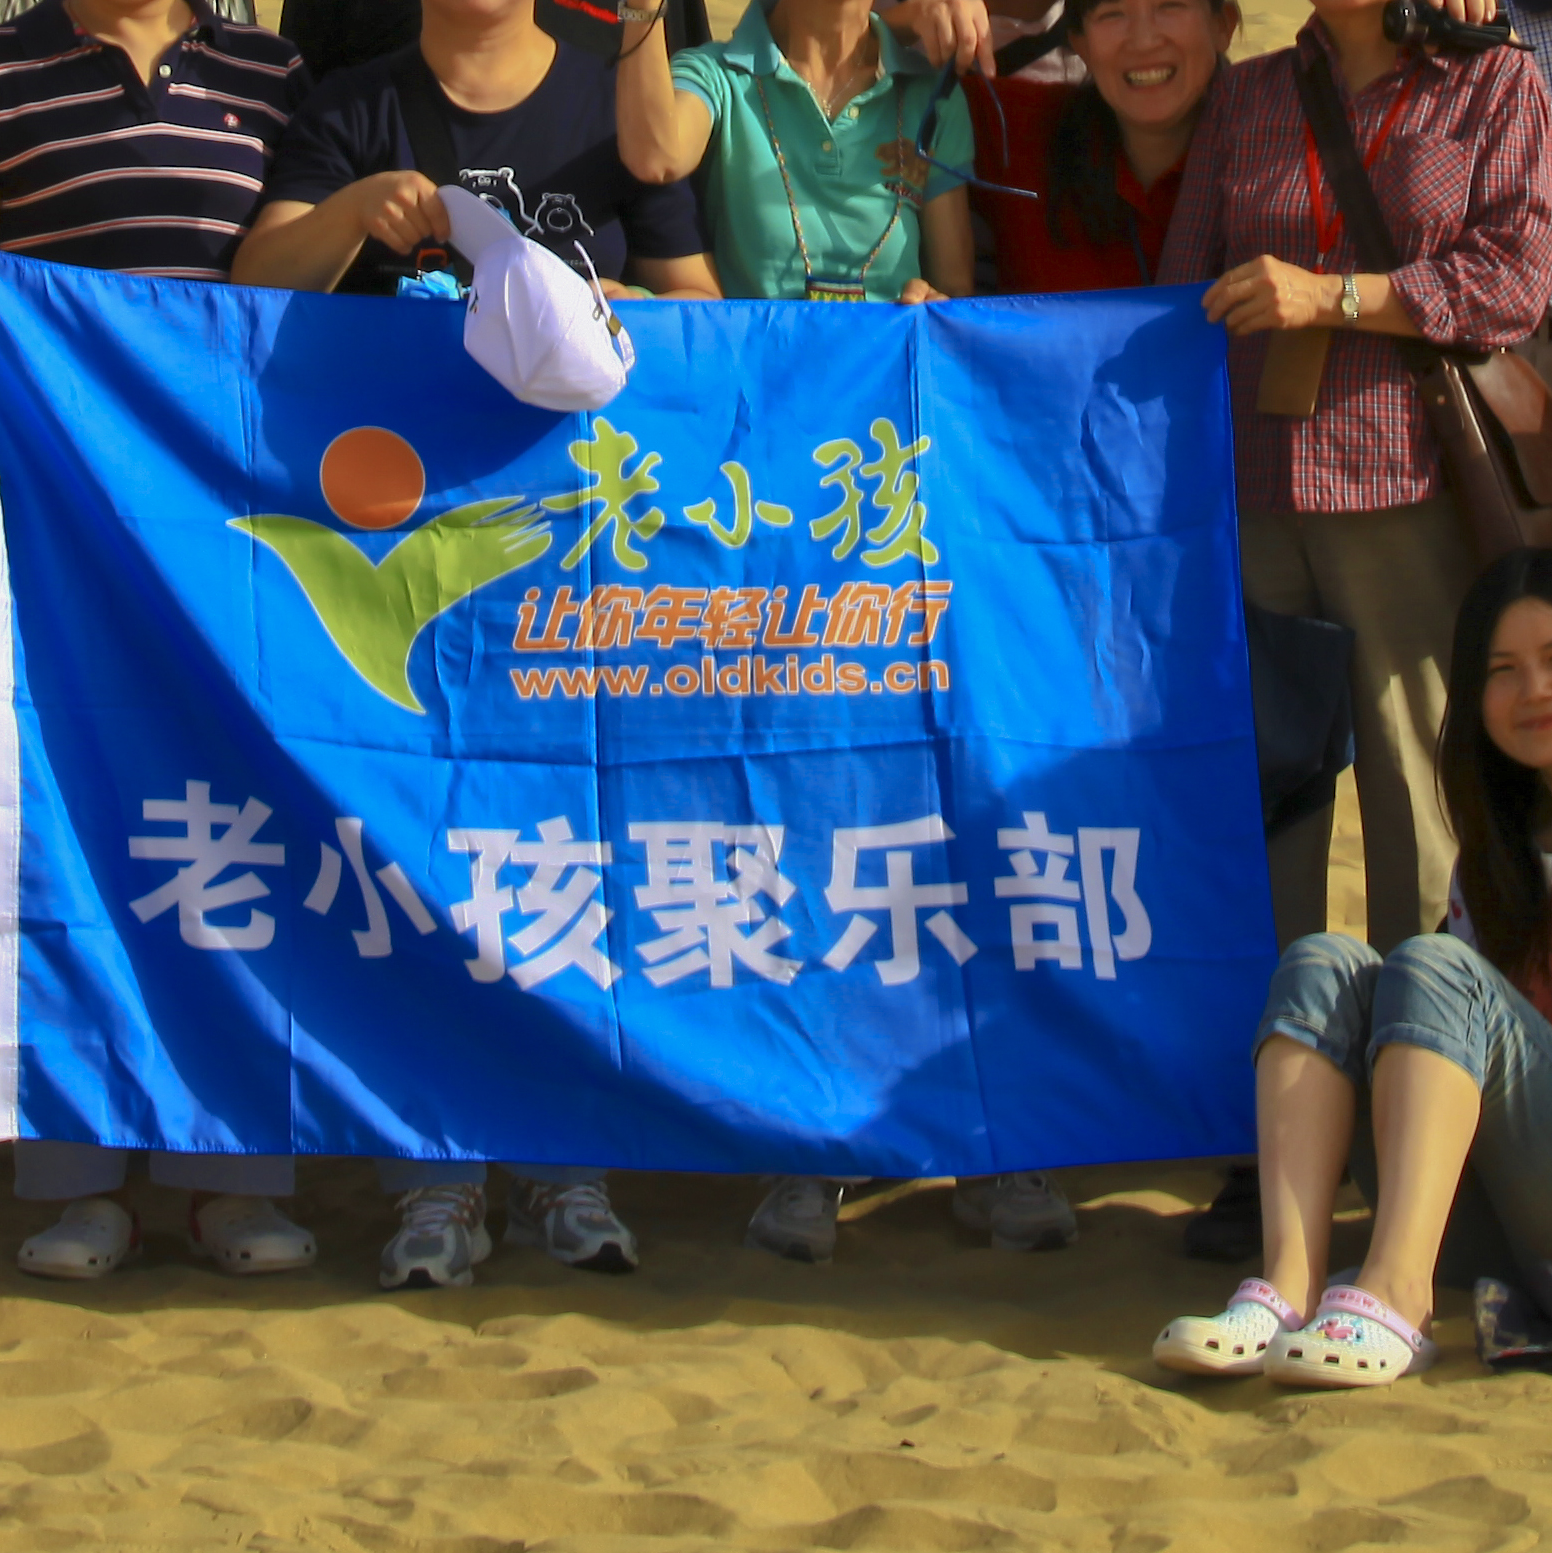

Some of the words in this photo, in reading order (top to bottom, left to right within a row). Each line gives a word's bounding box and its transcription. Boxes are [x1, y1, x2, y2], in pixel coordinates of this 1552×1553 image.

[542, 416, 939, 573] 老小孩
[512, 580, 954, 651] 让你年轻让你行
[510, 654, 951, 699] www.oldkids.cn
[127, 778, 1153, 991] 老小孩聚乐部
